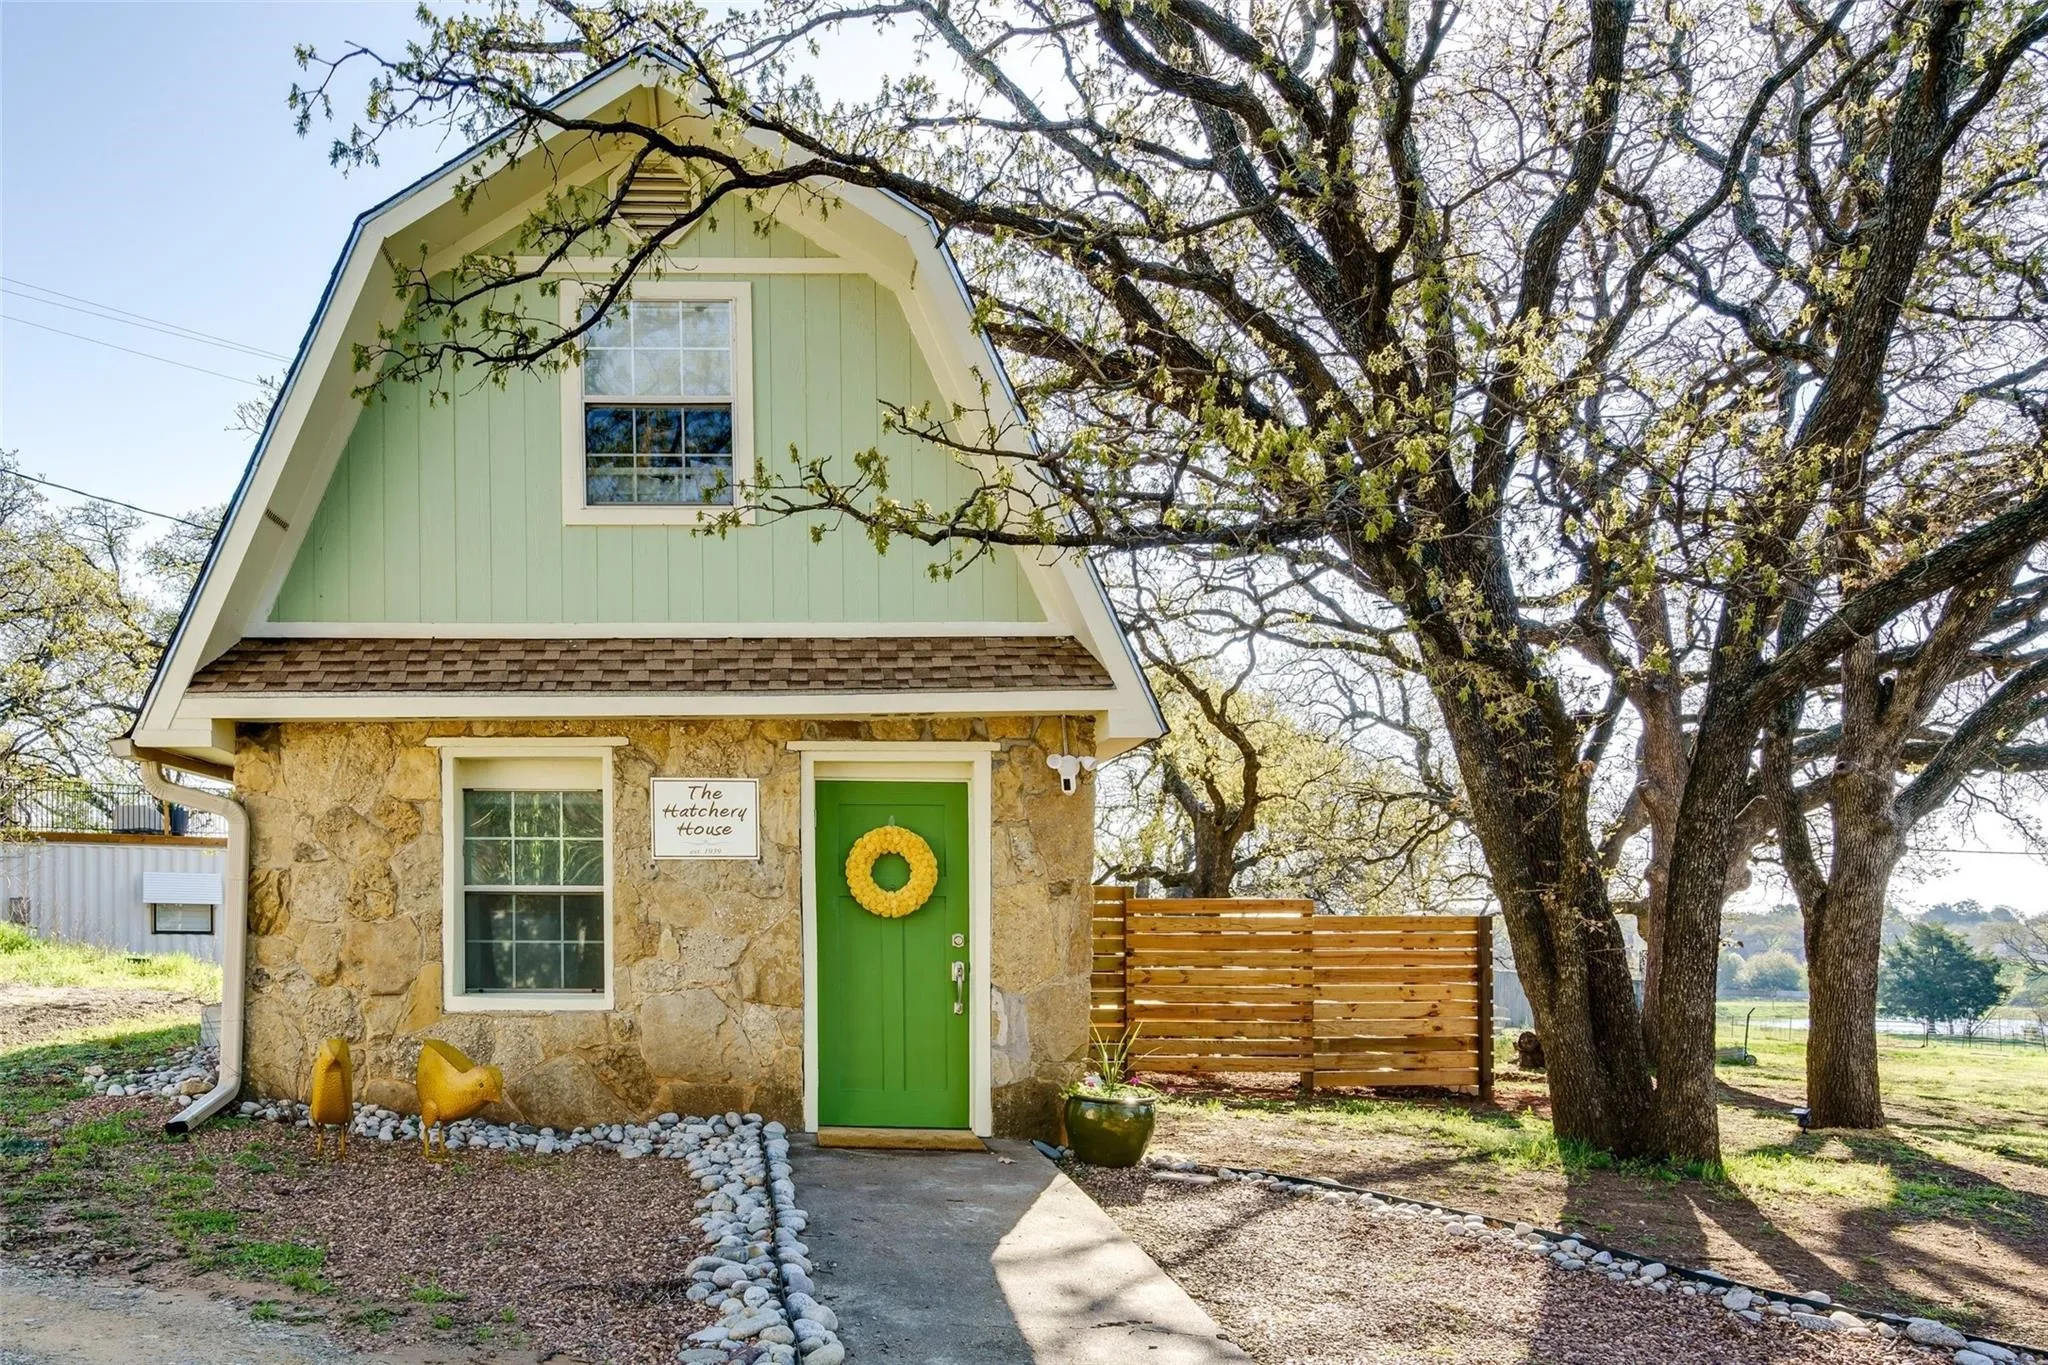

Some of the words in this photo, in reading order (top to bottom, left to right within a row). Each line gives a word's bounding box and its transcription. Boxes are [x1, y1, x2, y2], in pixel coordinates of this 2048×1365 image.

[688, 783, 724, 800] The
[662, 801, 748, 822] Hatchery
[677, 821, 733, 837] House
